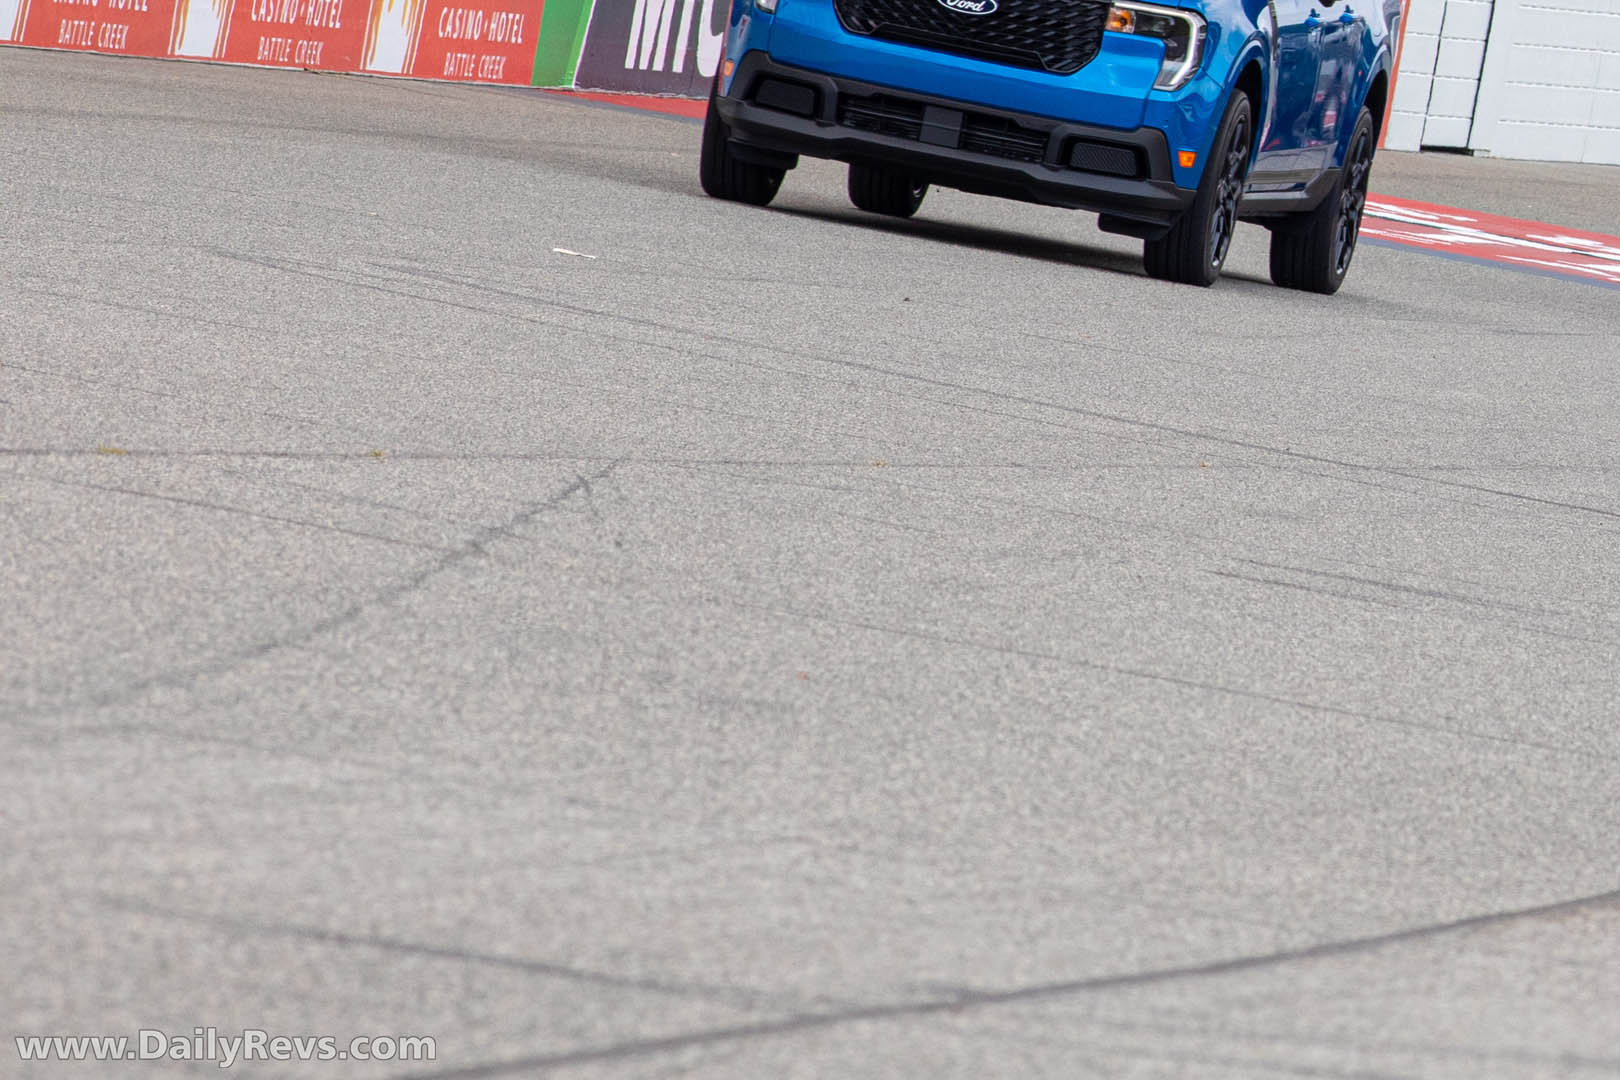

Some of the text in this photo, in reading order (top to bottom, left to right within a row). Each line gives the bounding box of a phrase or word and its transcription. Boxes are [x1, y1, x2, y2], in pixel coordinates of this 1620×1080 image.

[58, 19, 129, 49] BATTLE CREEK
[438, 7, 525, 44] CASINO HOTEL
[257, 36, 324, 65] BATTLE CREEK
[443, 52, 506, 79] BATTLE CREEK
